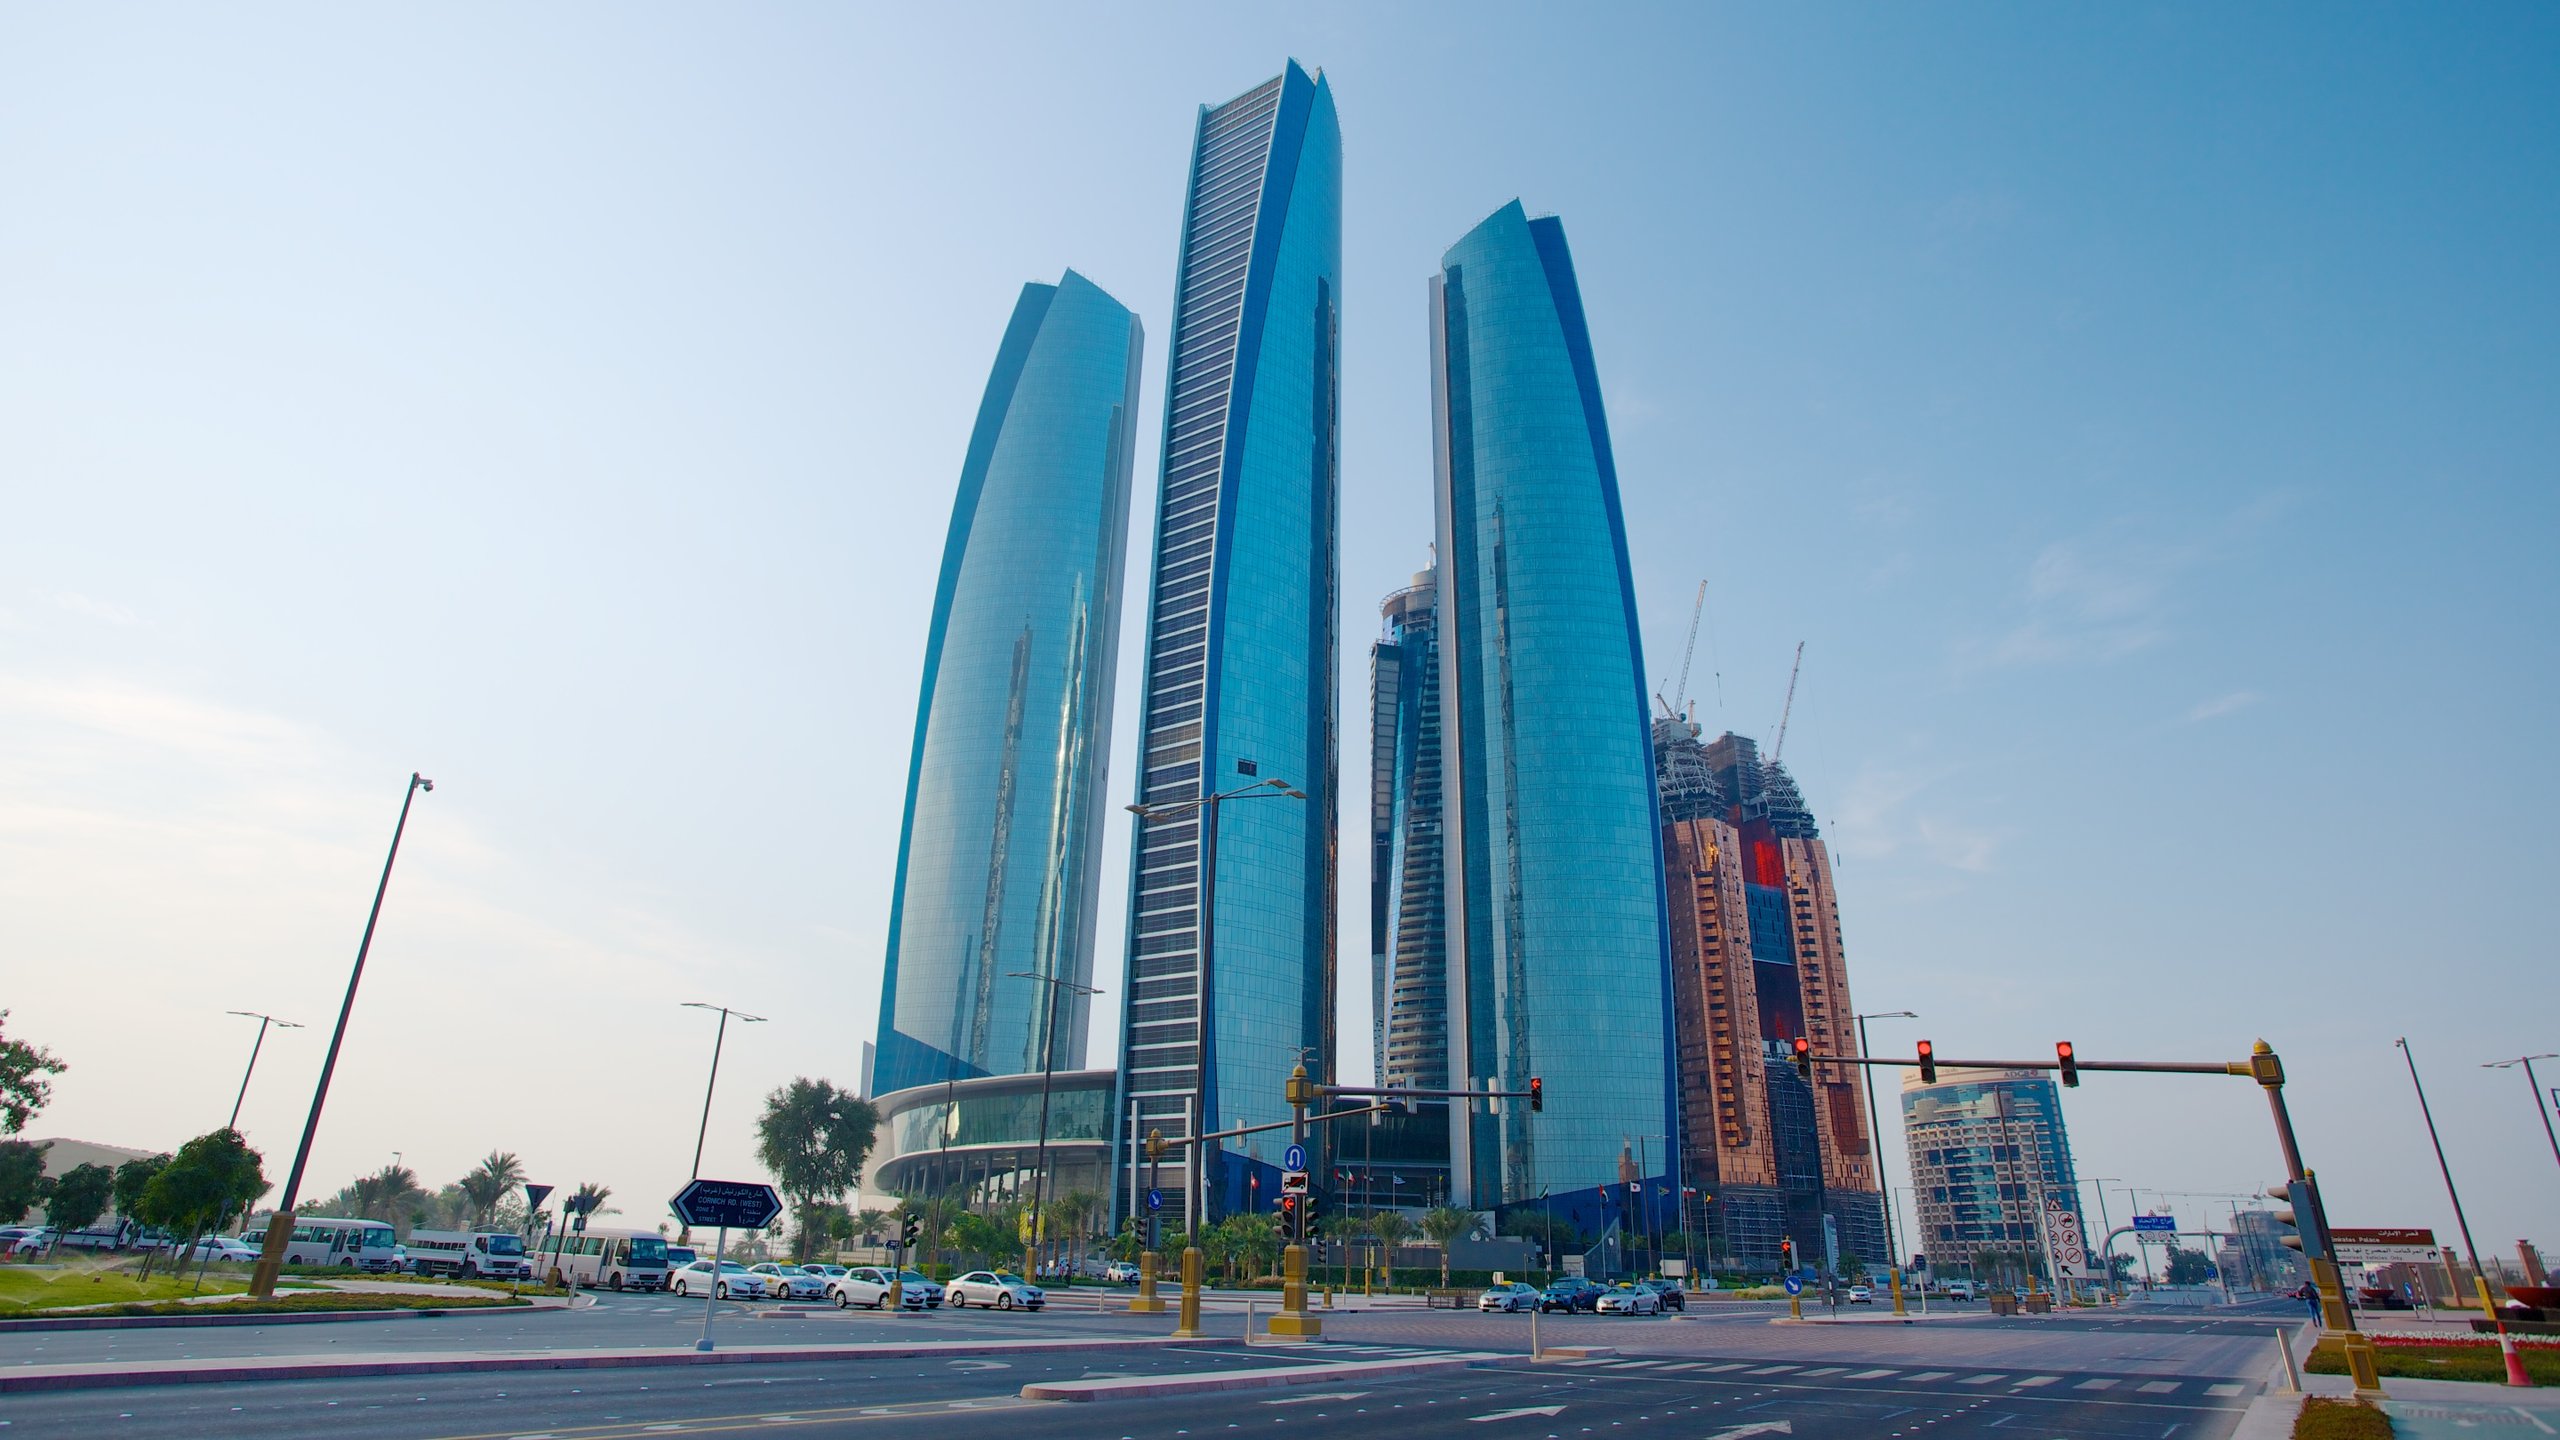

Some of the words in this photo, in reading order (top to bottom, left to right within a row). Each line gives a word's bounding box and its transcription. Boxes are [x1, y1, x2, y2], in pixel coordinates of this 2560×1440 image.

[2003, 1070, 2030, 1078] ADCB
[697, 1196, 726, 1206] CORNICH
[739, 1199, 763, 1208] (WEST)
[719, 1213, 724, 1223] 1
